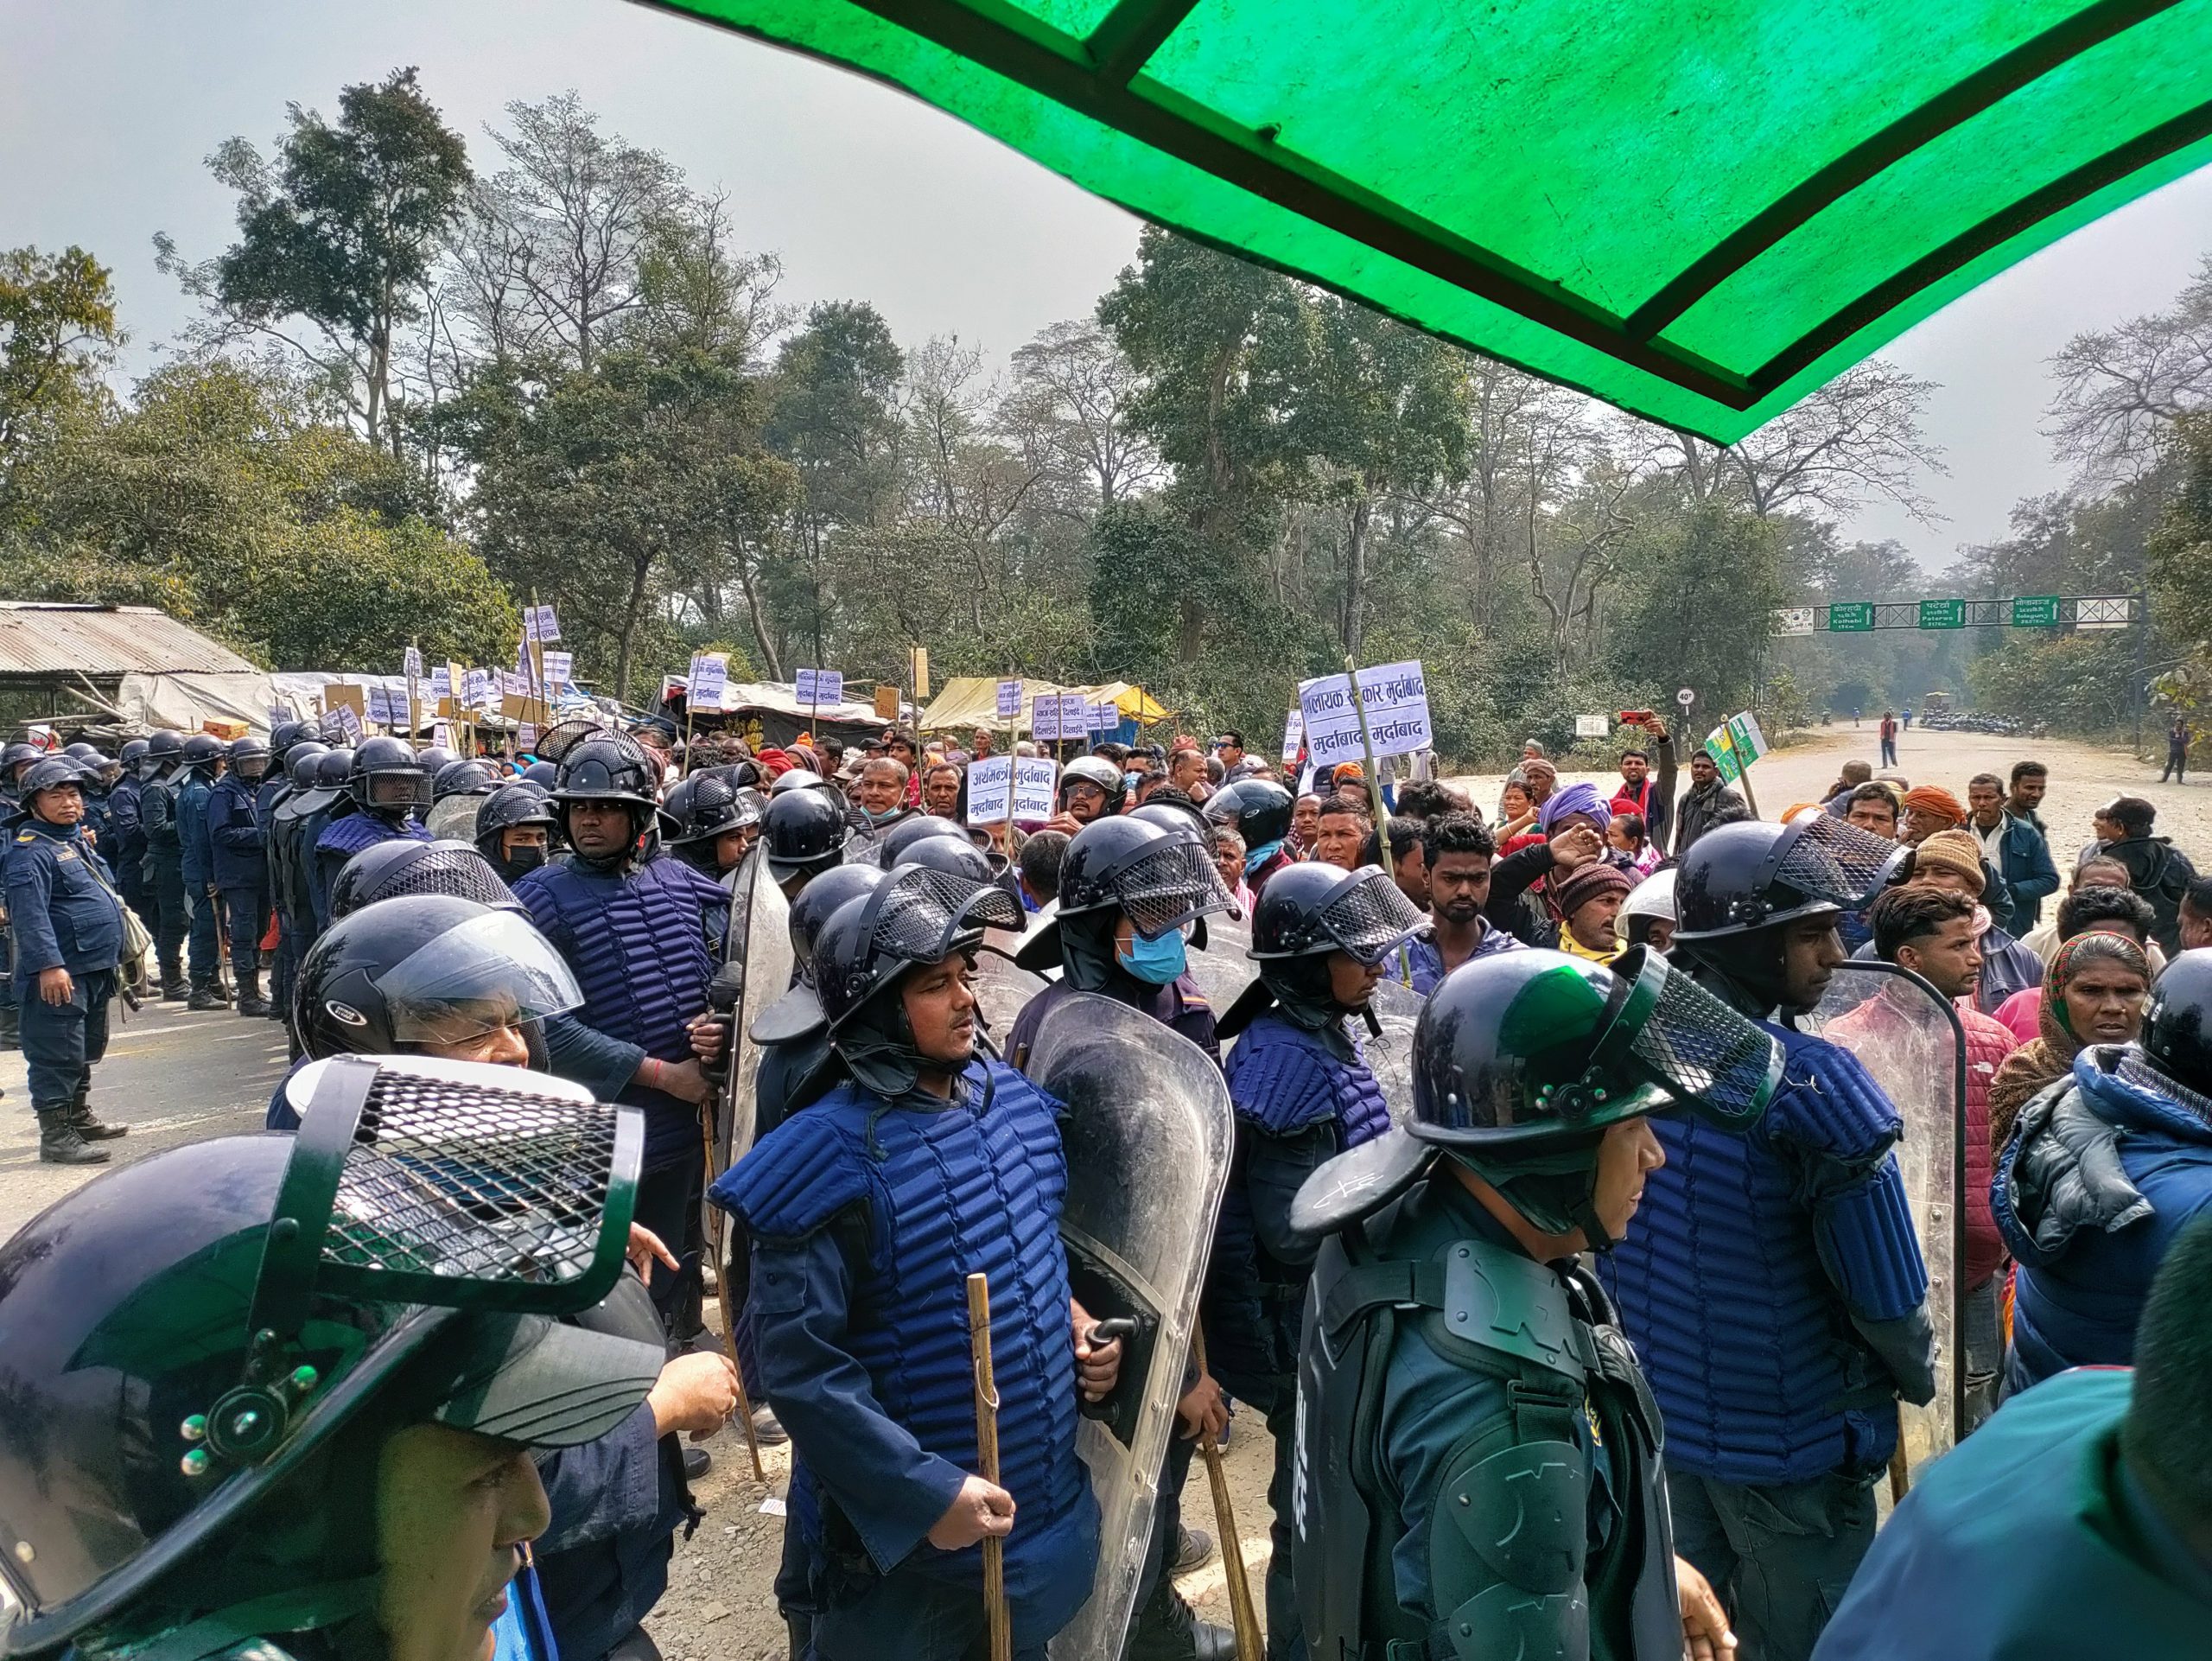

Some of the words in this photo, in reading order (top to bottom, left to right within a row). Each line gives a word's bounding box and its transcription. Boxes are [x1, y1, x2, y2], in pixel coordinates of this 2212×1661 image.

[1385, 674, 1425, 705] मुर्दाबाद
[1313, 729, 1364, 754] मुर्दाबाद
[1371, 720, 1423, 745] मुर्दाबाद
[1014, 766, 1051, 786] मुर्दाबाद
[970, 798, 1005, 817] मुर्दाबाद
